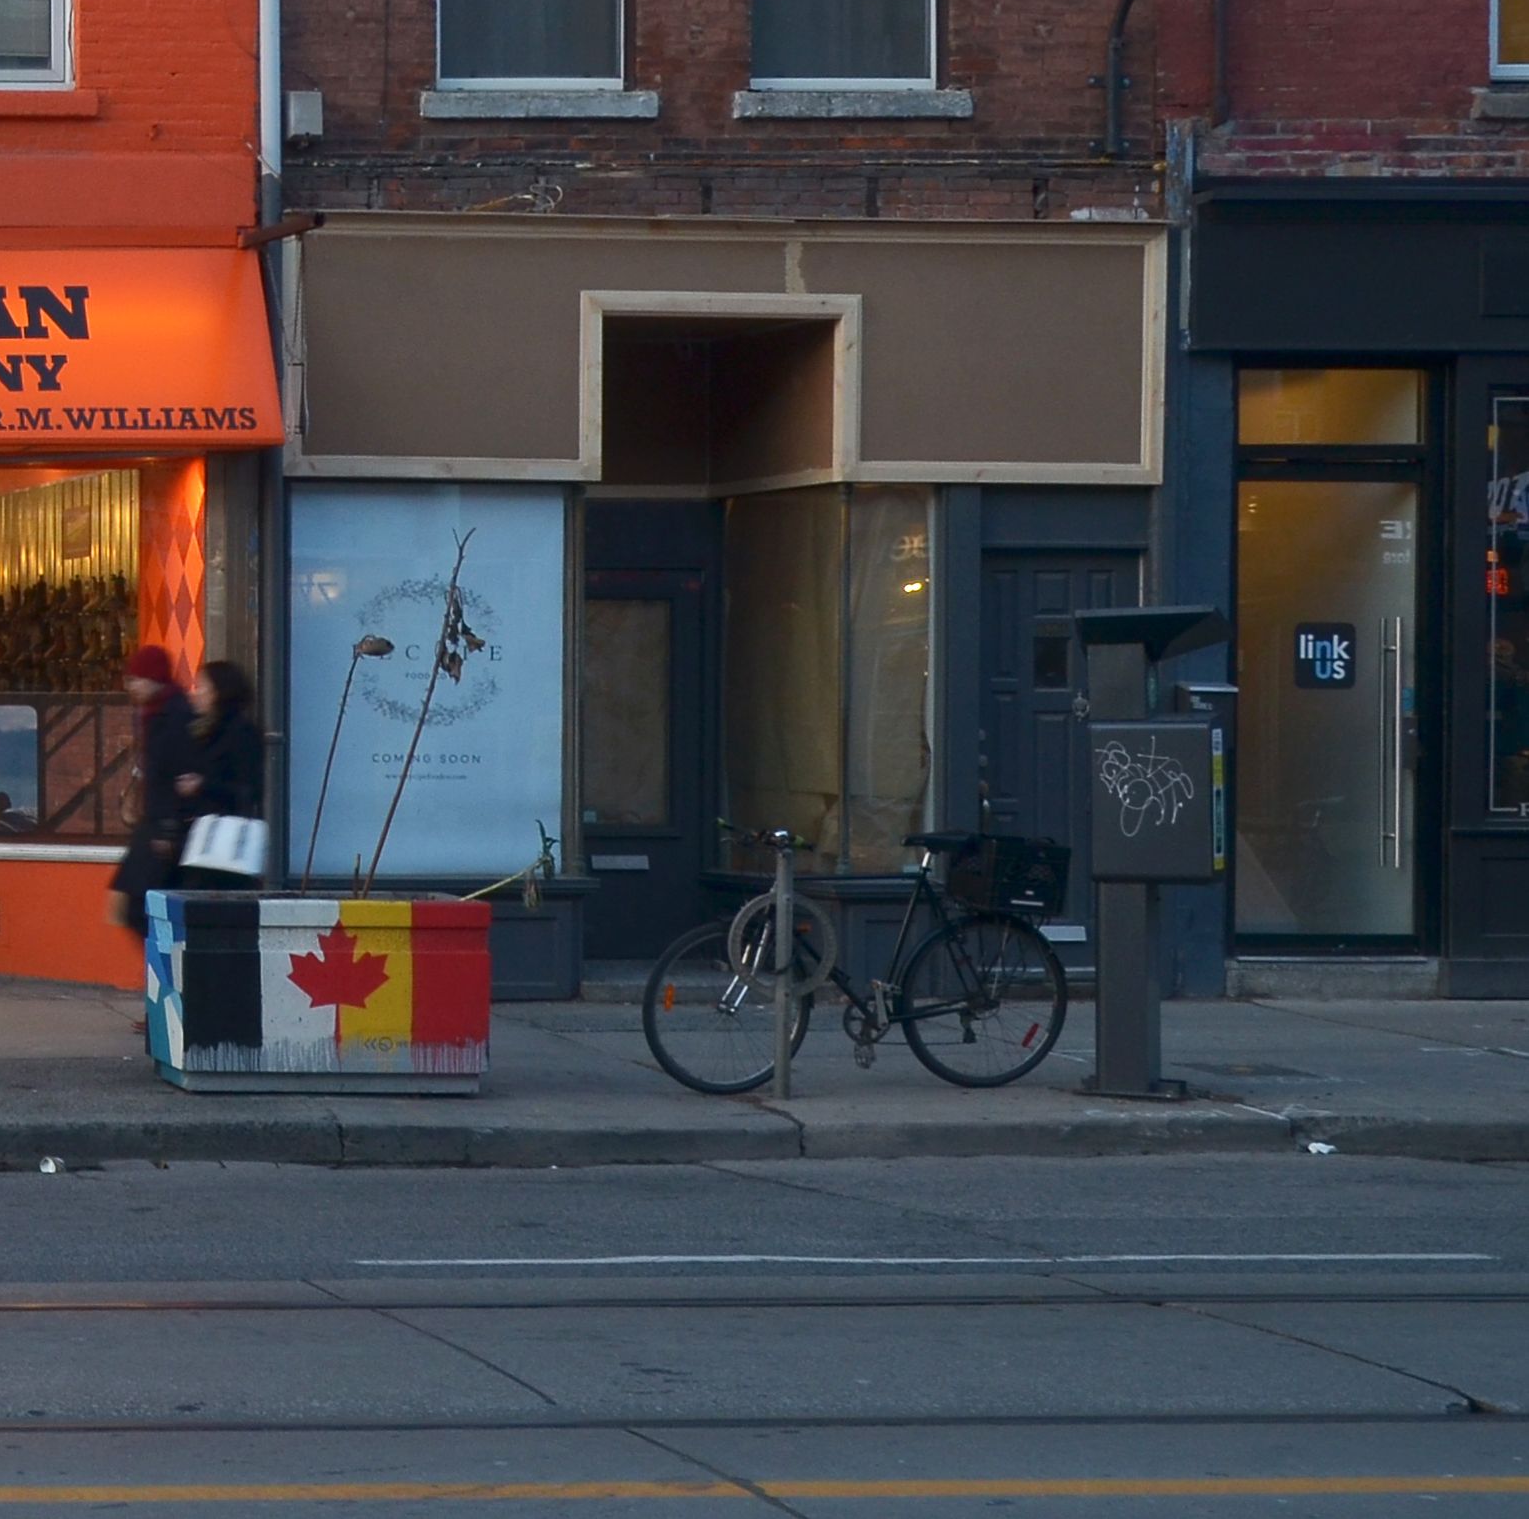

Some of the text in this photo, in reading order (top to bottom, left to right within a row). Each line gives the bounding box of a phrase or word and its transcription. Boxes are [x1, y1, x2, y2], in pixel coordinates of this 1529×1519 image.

[1299, 634, 1351, 659] link
[1315, 660, 1346, 680] us
[372, 753, 481, 764] COMNG SOON
